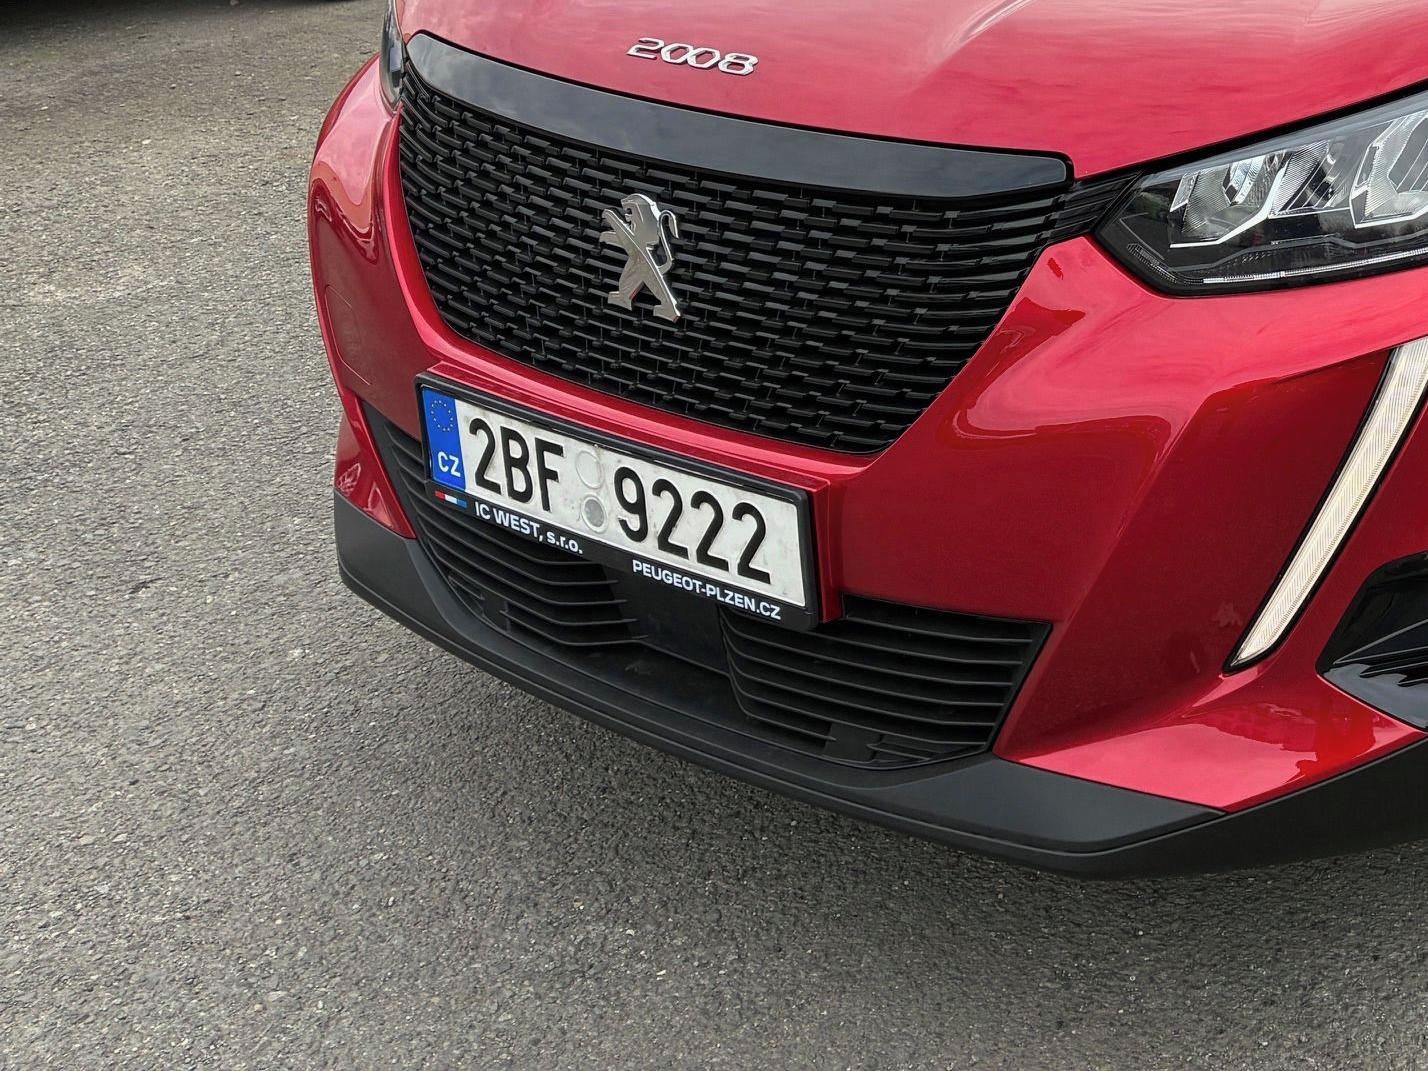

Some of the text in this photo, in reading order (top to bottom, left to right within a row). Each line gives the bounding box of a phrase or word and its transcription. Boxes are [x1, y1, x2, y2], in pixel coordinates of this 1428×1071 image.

[626, 37, 759, 76] 2008
[437, 451, 461, 478] CZ
[469, 417, 772, 586] 2BF 9222
[474, 501, 584, 555] IC WEST, s.r.o.
[632, 559, 782, 621] PEUGEOT-PLZEN.CZ
